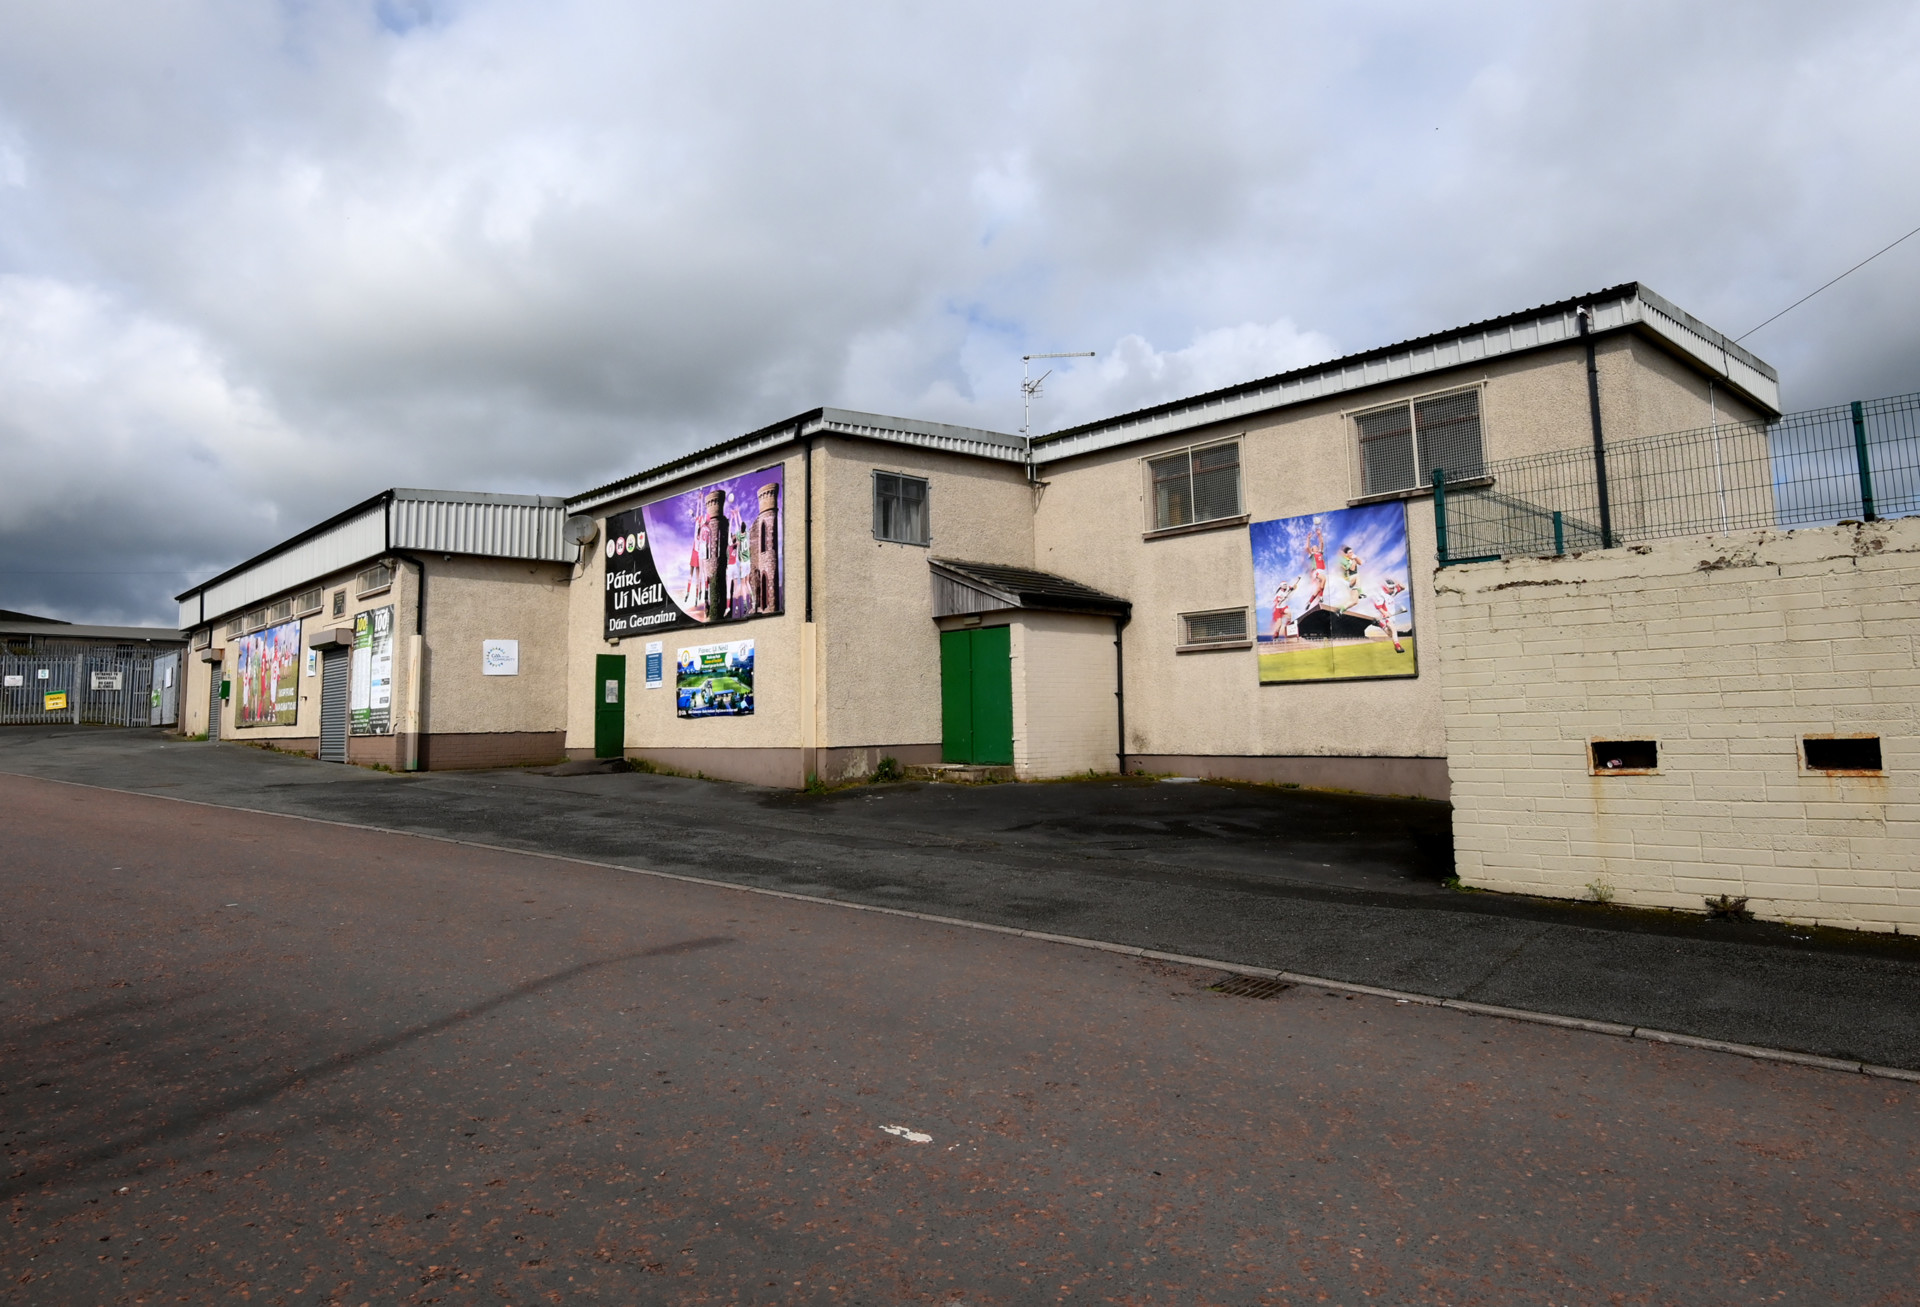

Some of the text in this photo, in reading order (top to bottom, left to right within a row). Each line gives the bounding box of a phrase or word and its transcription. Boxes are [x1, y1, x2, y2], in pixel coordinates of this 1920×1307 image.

[741, 540, 748, 552] 10
[606, 569, 642, 591] Páirc
[614, 583, 663, 610] Uí Néill
[629, 610, 677, 628] Geanainn
